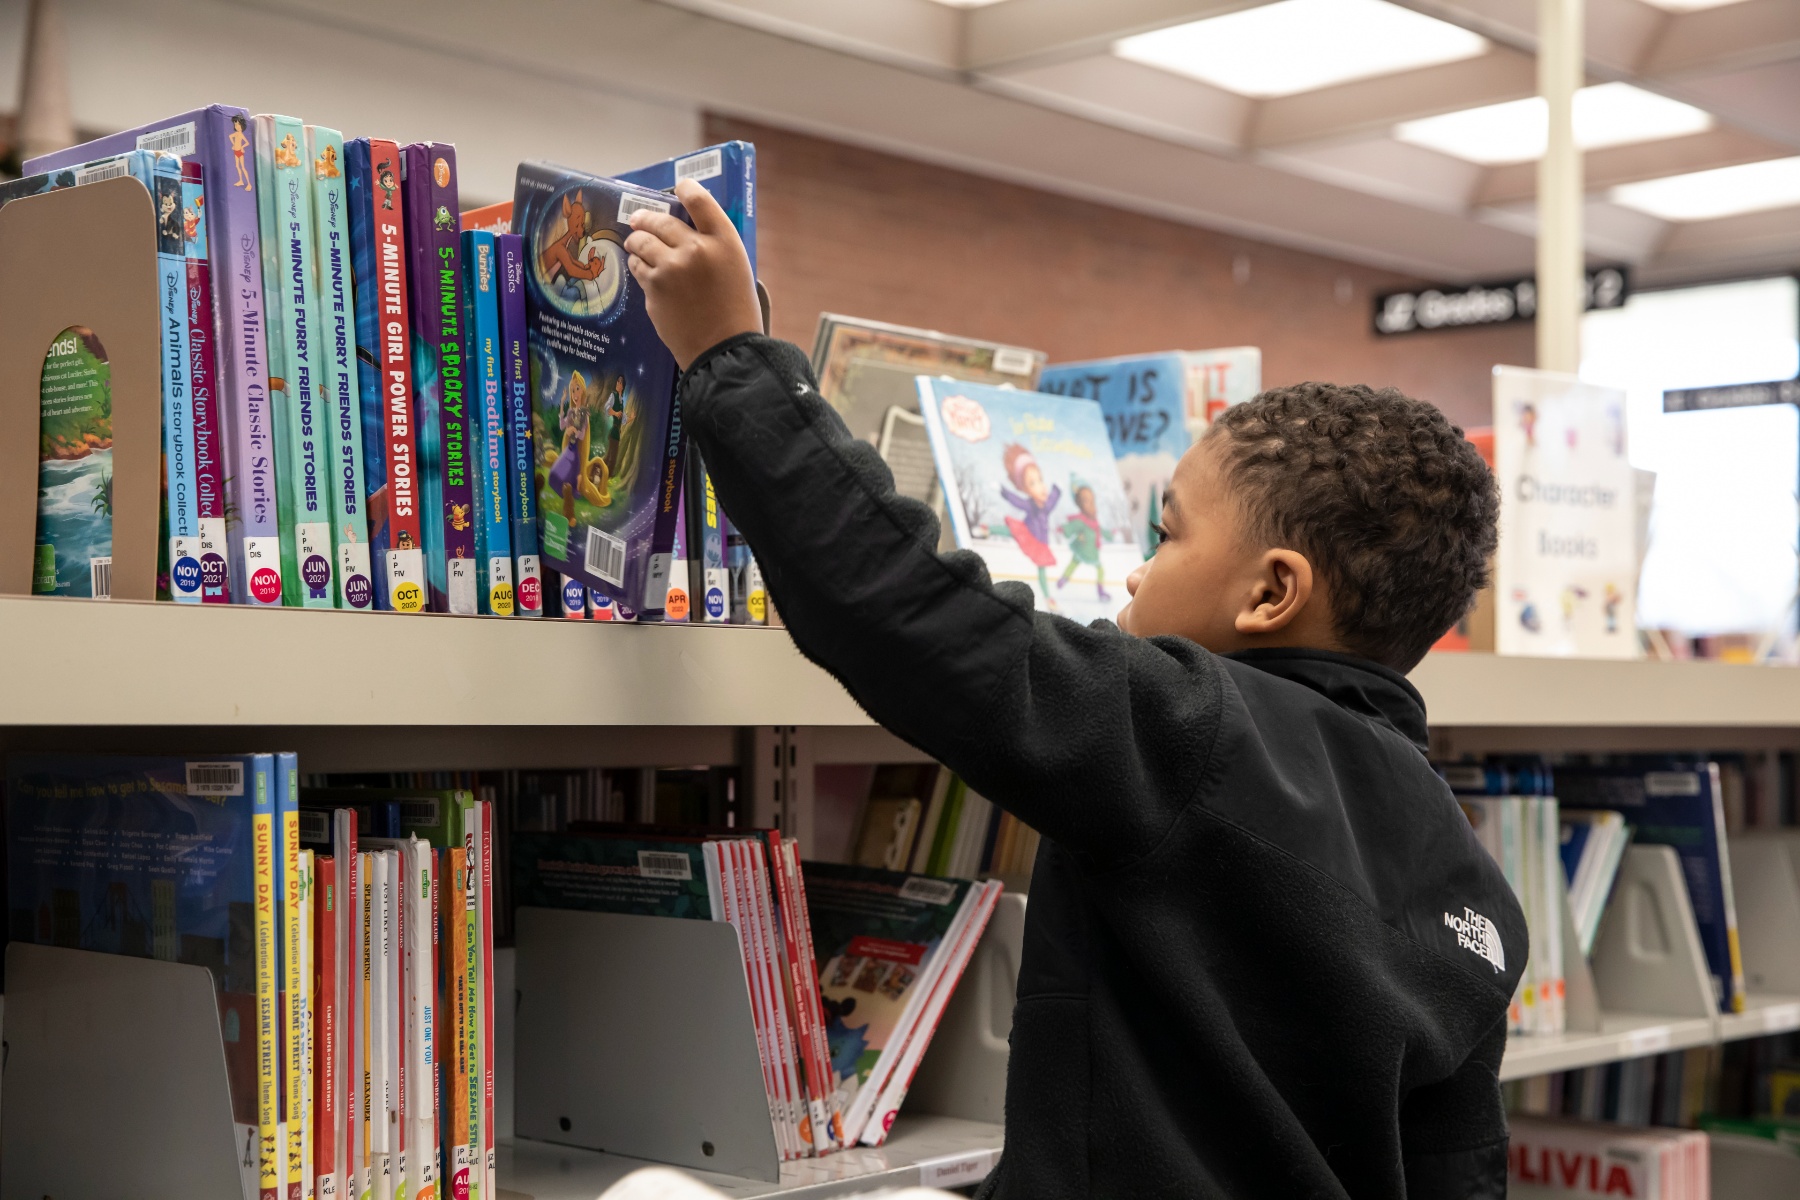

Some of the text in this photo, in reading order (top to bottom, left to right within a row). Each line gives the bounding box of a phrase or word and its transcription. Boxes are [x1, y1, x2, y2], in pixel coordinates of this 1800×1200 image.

[478, 244, 490, 292] Bunnies
[506, 251, 516, 293] CLASSICS
[190, 286, 201, 324] Disney
[166, 270, 184, 398] Disney Animals
[287, 178, 318, 512] Disney 5-MINUTE FURRY FRIENDS STORIES
[190, 328, 204, 385] Classic
[328, 188, 357, 515] Disney 5-MINUTE FURRY FRIENDS STORIES
[240, 231, 271, 524] Disney 5-Minute Classic Stories
[381, 223, 413, 517] 5-MINUTE GIRL POWER STORIES
[438, 247, 465, 486] 5-MINUTE SPOOKY STORIES
[1129, 369, 1159, 406] IS
[193, 387, 210, 471] Storybook
[484, 337, 502, 523] my first Bedtime storybook
[512, 340, 529, 524] my first Bedtime storybook
[663, 459, 677, 513] storybook
[1514, 474, 1620, 510] Character
[1537, 531, 1600, 559] Books
[177, 565, 199, 577] NOV
[201, 561, 225, 573] OCT
[203, 575, 222, 583] 2021
[254, 574, 277, 586] NOV
[305, 561, 326, 573] JUN
[308, 574, 326, 583] 2021
[180, 579, 195, 587] 2019
[348, 580, 368, 593] JUN
[397, 590, 419, 601] OCT
[493, 590, 512, 600] AUG
[522, 584, 540, 593] DEC
[566, 588, 583, 598] NOV
[351, 593, 368, 602] 2021
[668, 595, 686, 604] APR
[708, 595, 723, 605] NOV
[149, 777, 187, 793] Sesame
[257, 823, 268, 877] SUNNY
[289, 820, 298, 873] SUNNY
[350, 870, 357, 884] DO
[483, 858, 490, 872] DO
[258, 884, 269, 913] DAY
[290, 880, 299, 909] DAY
[1444, 911, 1487, 945] NORTH
[1464, 906, 1487, 931] THE
[260, 927, 270, 970] Celebration
[291, 923, 300, 965] Celebration
[1457, 932, 1489, 960] FACE
[261, 971, 270, 980] of
[292, 966, 301, 976] of
[261, 981, 269, 994] the
[791, 962, 800, 985] Daniel
[800, 1011, 809, 1036] School
[261, 997, 271, 1036] SESAME
[292, 993, 300, 1031] SESAME
[459, 1016, 464, 1025] TO
[467, 923, 478, 1120] Can You Tell Me How to Get to SESAME
[424, 1005, 432, 1065] JUST ONE YOU!
[262, 1039, 272, 1077] STREET
[292, 1034, 300, 1071] STREET
[262, 1081, 272, 1105] Theme
[292, 1075, 301, 1099] Theme
[262, 1107, 272, 1126] Song
[292, 1101, 300, 1120] Song
[936, 1161, 978, 1177] Daniel Tiger
[1508, 1142, 1636, 1198] LIVIA
[323, 1185, 335, 1195] KLE
